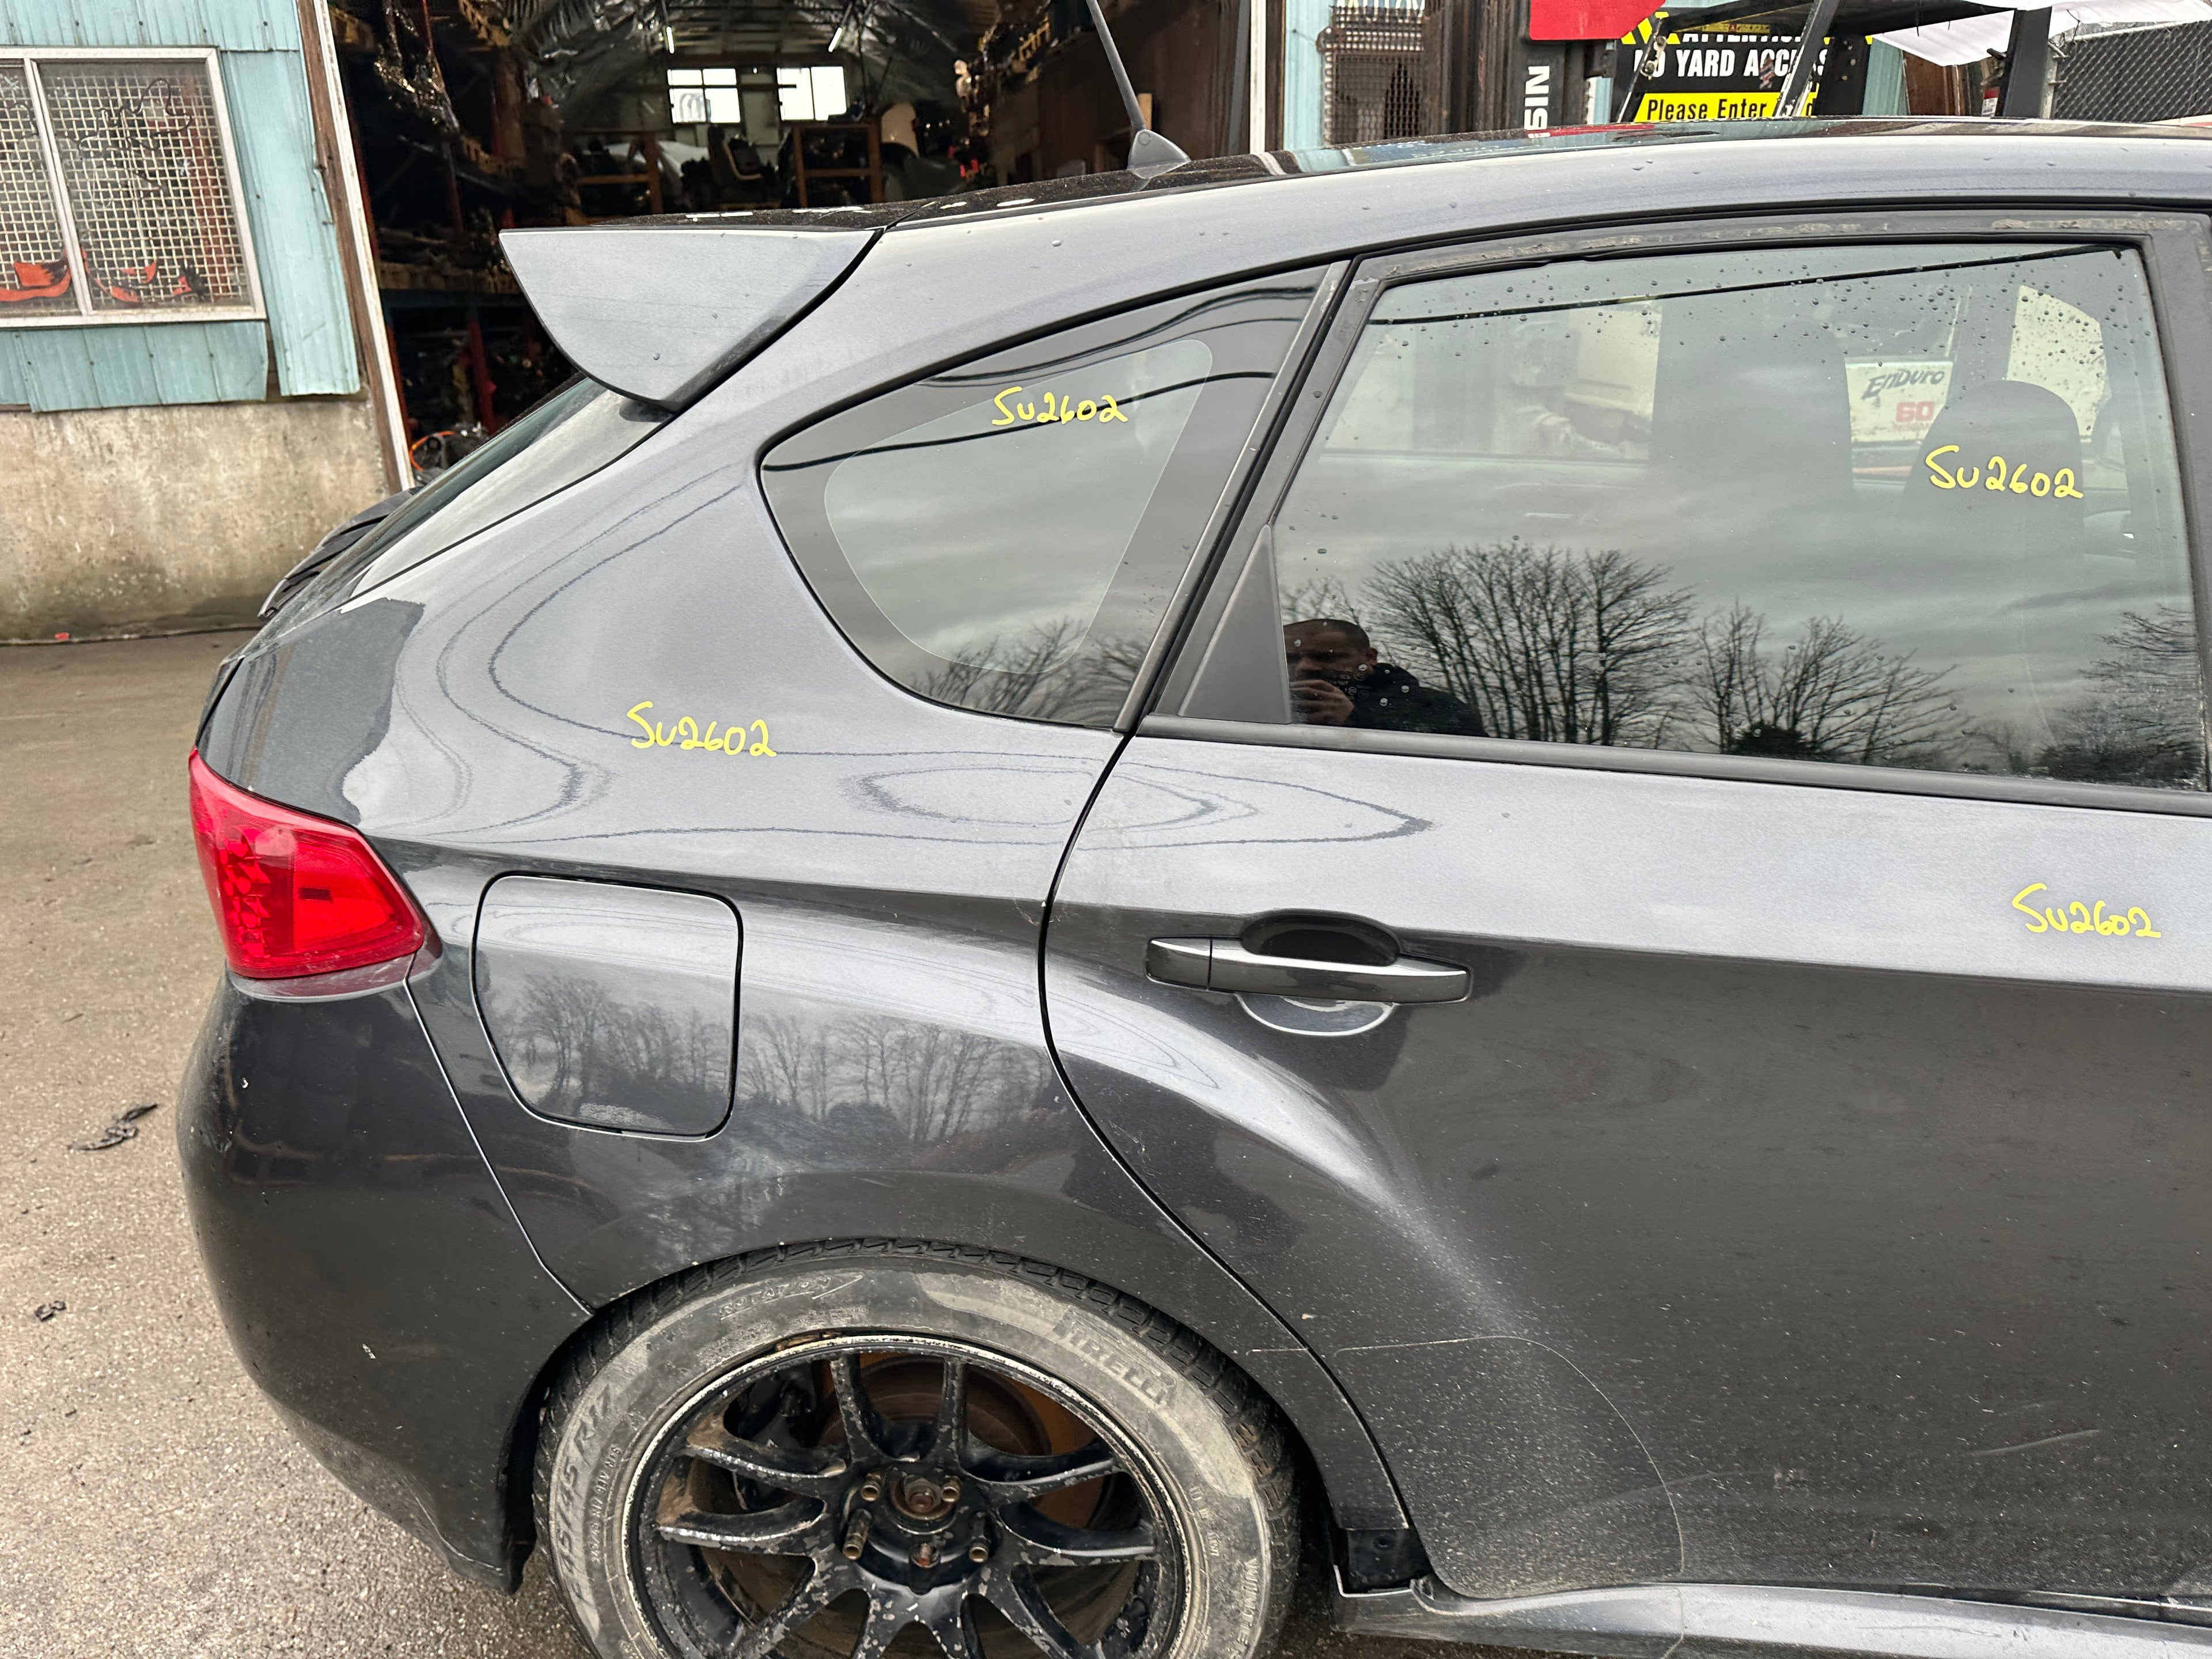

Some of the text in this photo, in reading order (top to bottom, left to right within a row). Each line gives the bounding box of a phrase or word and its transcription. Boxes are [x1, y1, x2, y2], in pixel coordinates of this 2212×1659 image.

[1676, 49, 1734, 77] YARD
[1744, 48, 1828, 77] ACCS
[1647, 99, 1767, 120] Please Enter
[1052, 1305, 1179, 1404] PIRELLI
